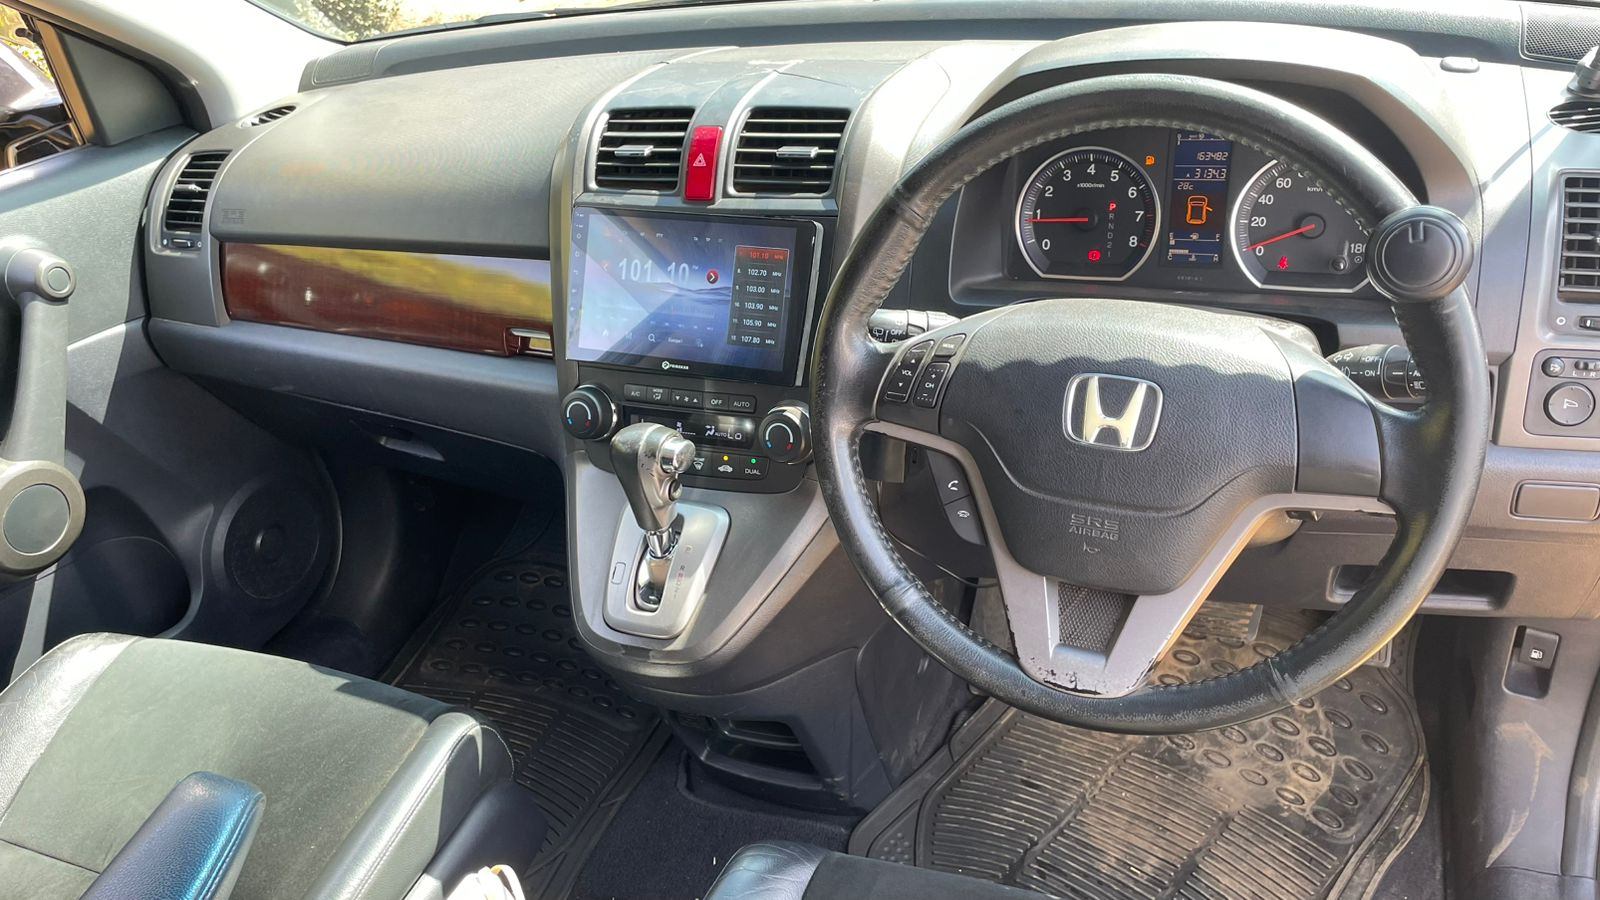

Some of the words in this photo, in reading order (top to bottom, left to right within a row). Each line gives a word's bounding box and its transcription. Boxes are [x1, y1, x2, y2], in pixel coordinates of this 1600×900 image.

[1197, 152, 1228, 160] 163482
[1087, 164, 1096, 176] 4
[1062, 170, 1072, 182] 3
[1110, 170, 1119, 182] 5
[1276, 178, 1292, 188] 60
[1044, 186, 1053, 197] 2
[1128, 186, 1137, 198] 6
[1258, 194, 1274, 205] 40
[1109, 202, 1116, 211] P
[1036, 208, 1041, 219] 1
[1135, 211, 1144, 222] 7
[1251, 216, 1266, 227] 20
[1042, 239, 1050, 250] 0
[1129, 236, 1138, 247] 8
[1256, 246, 1264, 256] 0
[748, 268, 767, 277] 102.70
[746, 285, 766, 293] 103.00
[744, 302, 764, 310] 103.90
[1071, 513, 1119, 530] SRS
[1068, 525, 1119, 540] AIRBAG
